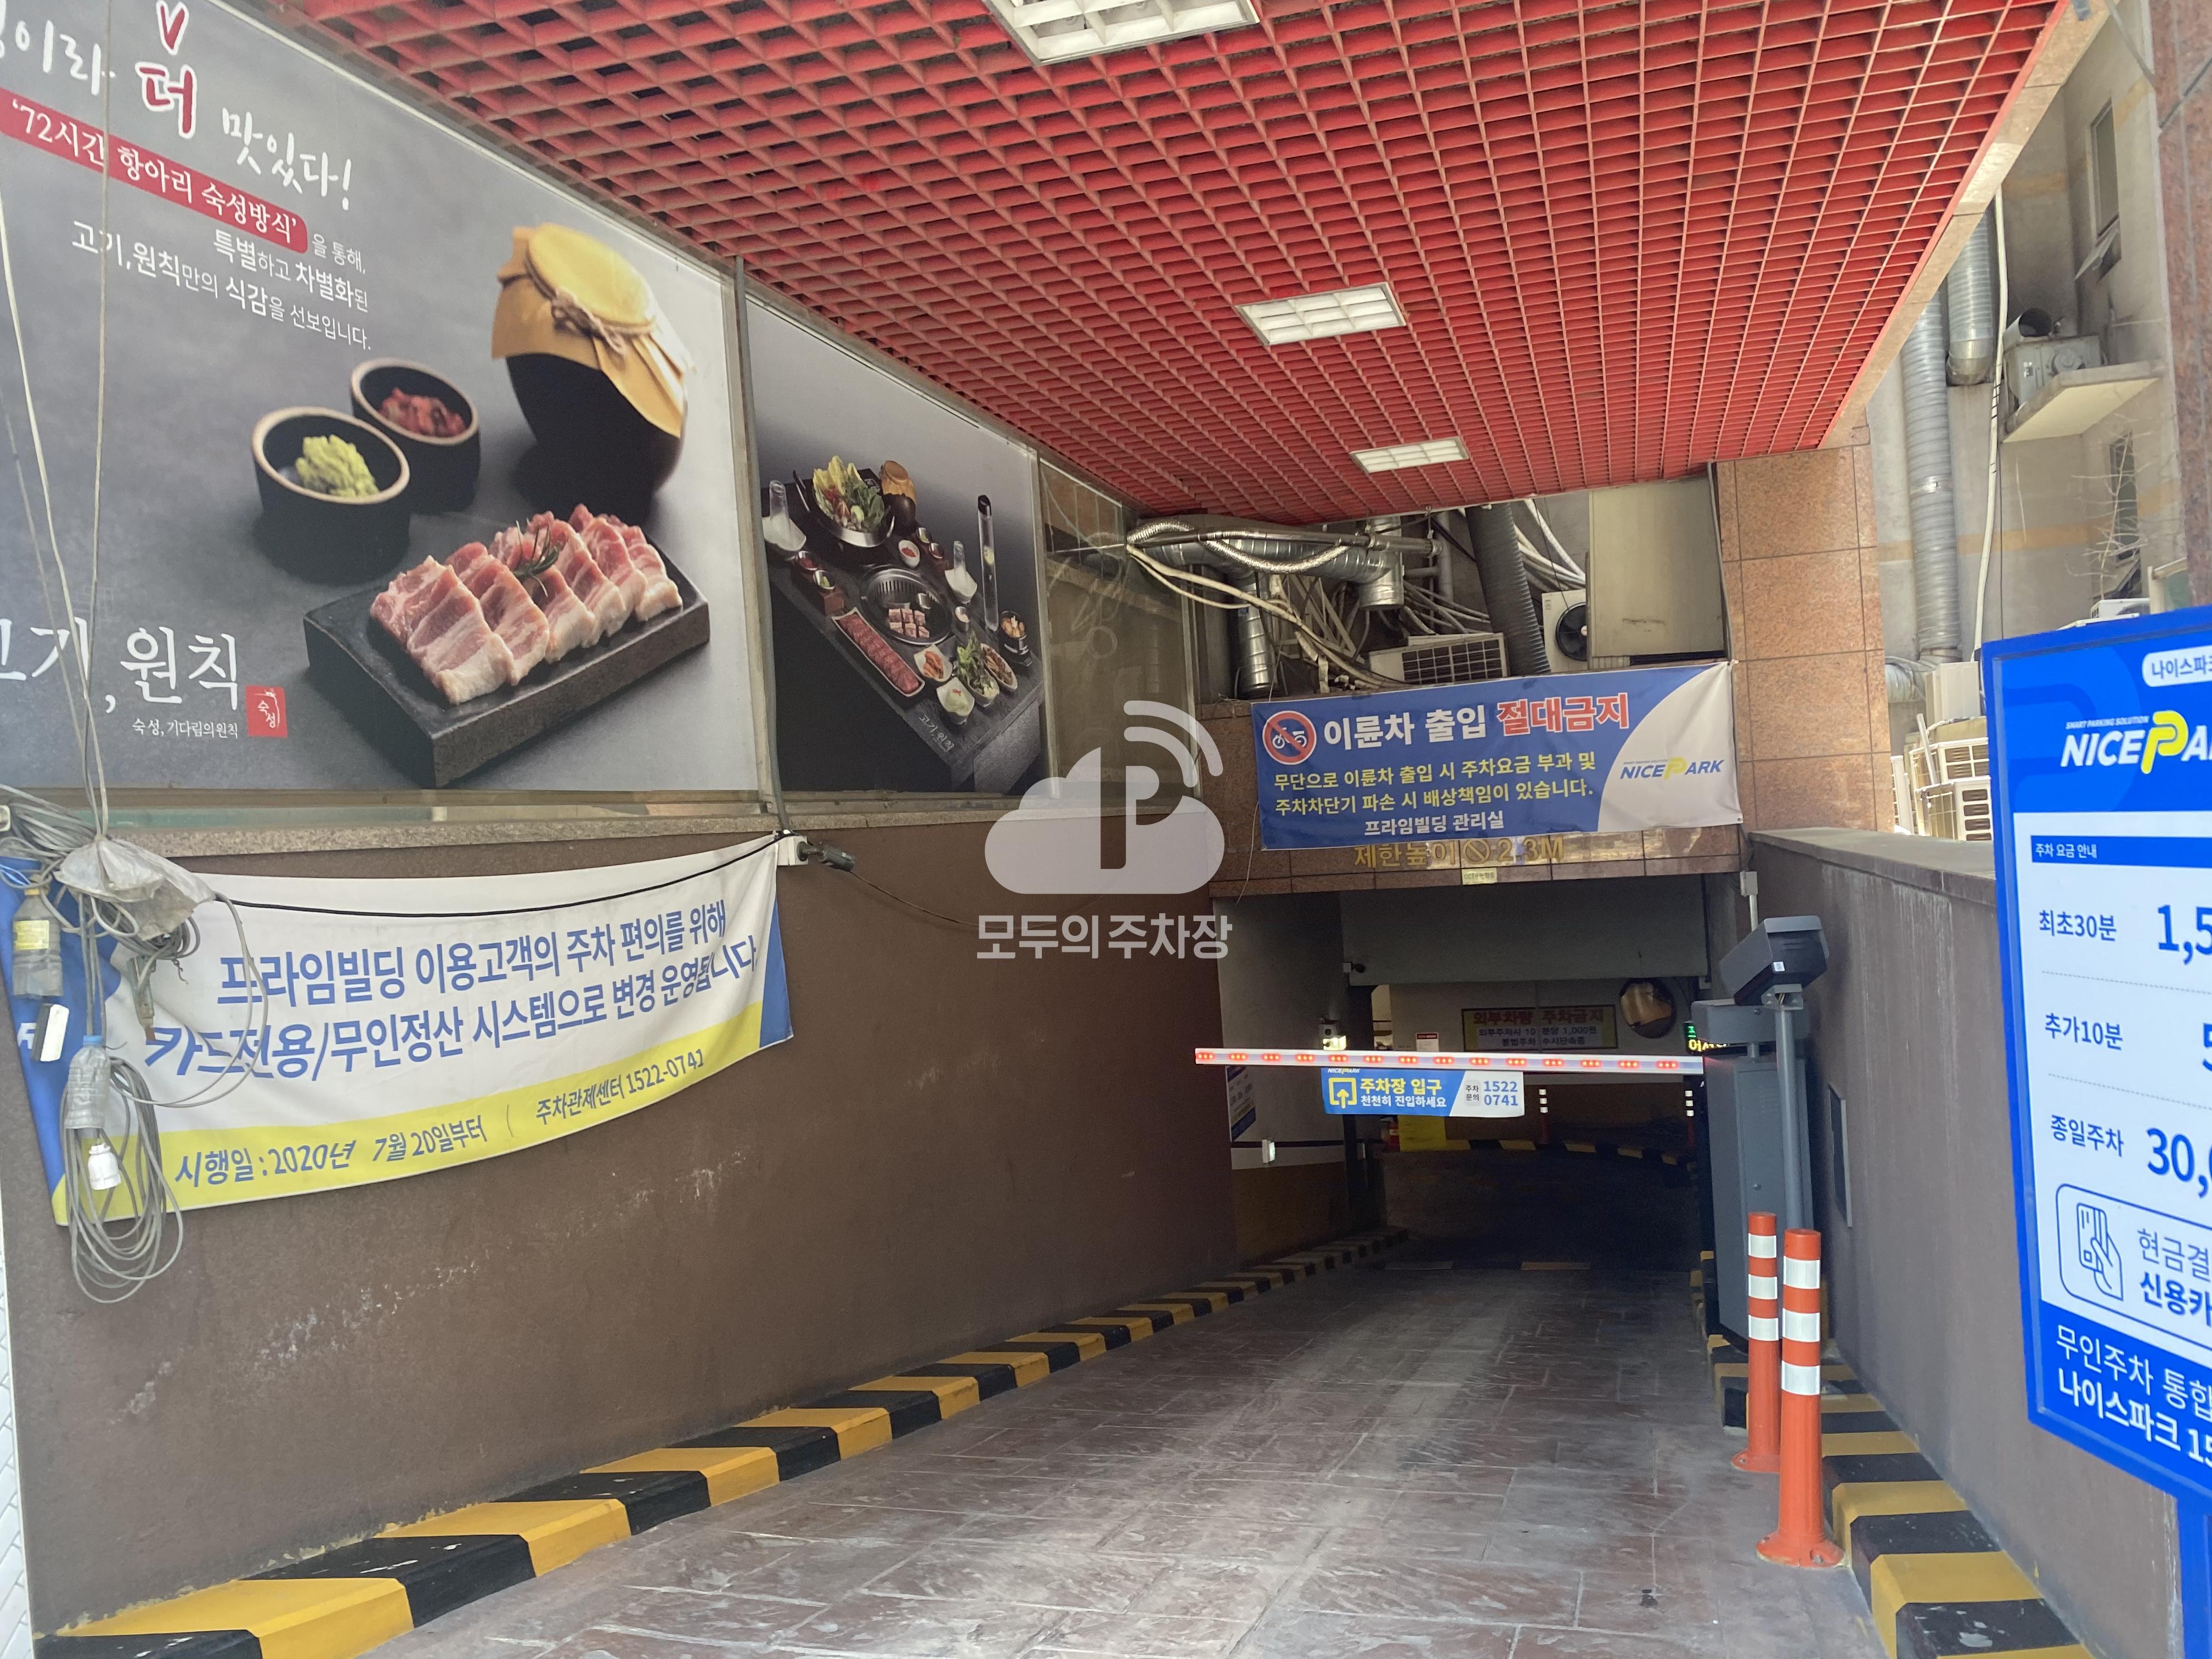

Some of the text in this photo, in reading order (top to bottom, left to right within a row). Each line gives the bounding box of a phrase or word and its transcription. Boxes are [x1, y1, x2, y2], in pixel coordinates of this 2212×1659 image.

[0, 0, 351, 210] 이라 더 맛있다!
[117, 145, 193, 204] 항아리
[213, 228, 369, 313] 특별하고 차별화된
[225, 276, 285, 322] 식감을
[290, 304, 371, 350] 선보입니다.
[2151, 654, 2212, 679] 나이스파
[1324, 692, 1629, 750] 이륜차 출입 절대금지
[2066, 720, 2086, 729] SMART
[2115, 715, 2149, 726] SOLUTION
[2060, 710, 2212, 774] NICEPA
[1274, 751, 1595, 791] 무단으로 이륜차 출입 시 주차요금 부과 및
[1276, 779, 1593, 816] 주차차단기 파손 시 배상책임이 있습니다.
[1364, 810, 1504, 836] 프라임빌딩 관리실
[1354, 840, 1455, 868] 제한높이
[2036, 843, 2097, 859] 주차 요금 안내
[2039, 910, 2117, 941] 최초30분
[218, 900, 726, 1007] 프라임빌딩 이용고객의 주차 편의를 위해
[472, 985, 607, 1048] 시스템으로
[613, 969, 654, 1020] 변경
[1474, 1008, 1604, 1025] 외부차량 주차금지
[2045, 1013, 2123, 1051] 추가10분
[536, 1048, 704, 1125] 주차관제센터 1522-0741
[1361, 1078, 1442, 1096] 주차장 입구
[1361, 1095, 1447, 1108] 천천히 진입하세요
[1466, 1085, 1479, 1093] 주차
[1466, 1093, 1480, 1102] 문의
[1484, 1081, 1517, 1092] 1522
[1484, 1094, 1519, 1106] 0741
[372, 1132, 408, 1163] 7월
[411, 1115, 488, 1156] 20일부터
[2050, 1114, 2124, 1157] 종일주차
[2147, 1128, 2212, 1199] 30,
[2057, 1324, 2154, 1396] 무인주차
[2059, 1368, 2181, 1452] 나이스파크
